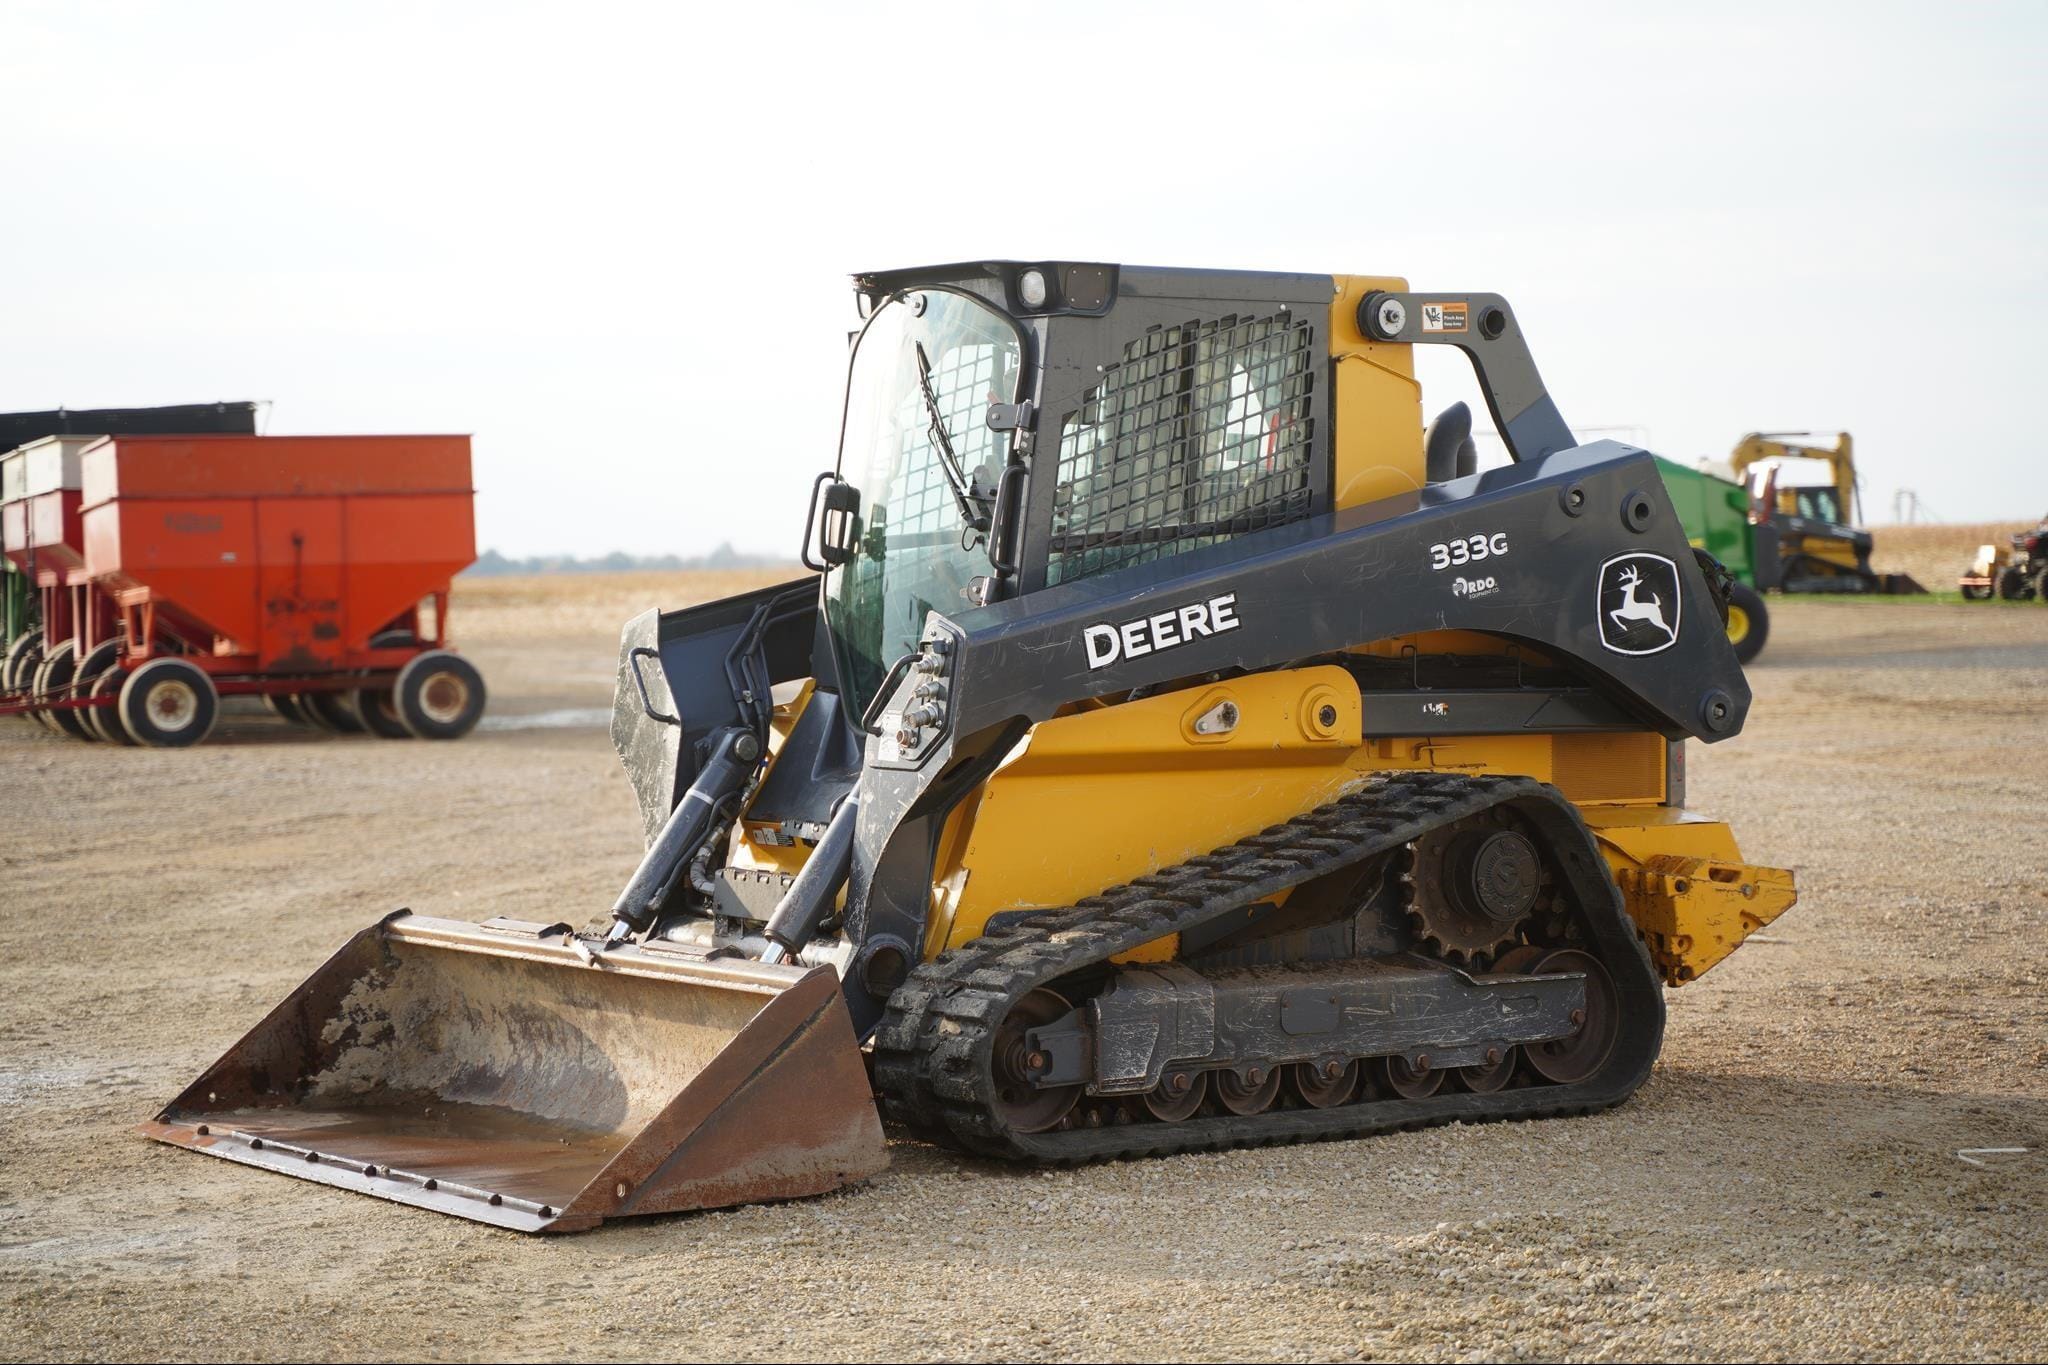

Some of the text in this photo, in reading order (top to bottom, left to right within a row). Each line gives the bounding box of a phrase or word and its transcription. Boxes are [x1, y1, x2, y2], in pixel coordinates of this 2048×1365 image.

[1430, 532, 1508, 570] 333G
[1468, 576, 1495, 594] RDO
[1084, 593, 1240, 670] DEERE
